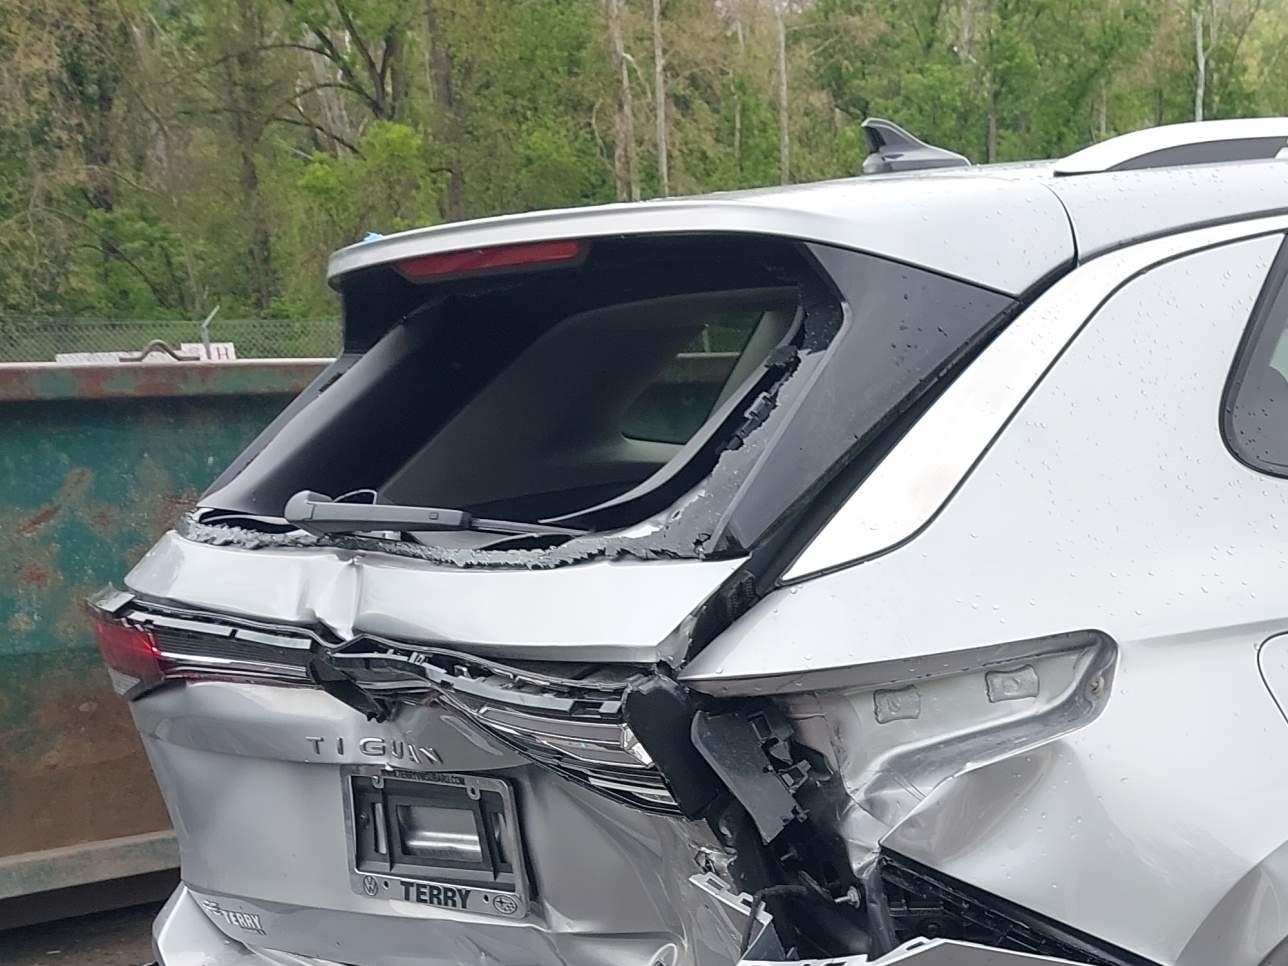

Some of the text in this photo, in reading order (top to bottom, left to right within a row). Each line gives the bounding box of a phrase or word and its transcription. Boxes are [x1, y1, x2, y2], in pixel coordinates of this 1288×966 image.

[305, 736, 443, 764] TIGUAN
[400, 881, 471, 909] TERRY
[220, 910, 262, 929] TERRY
